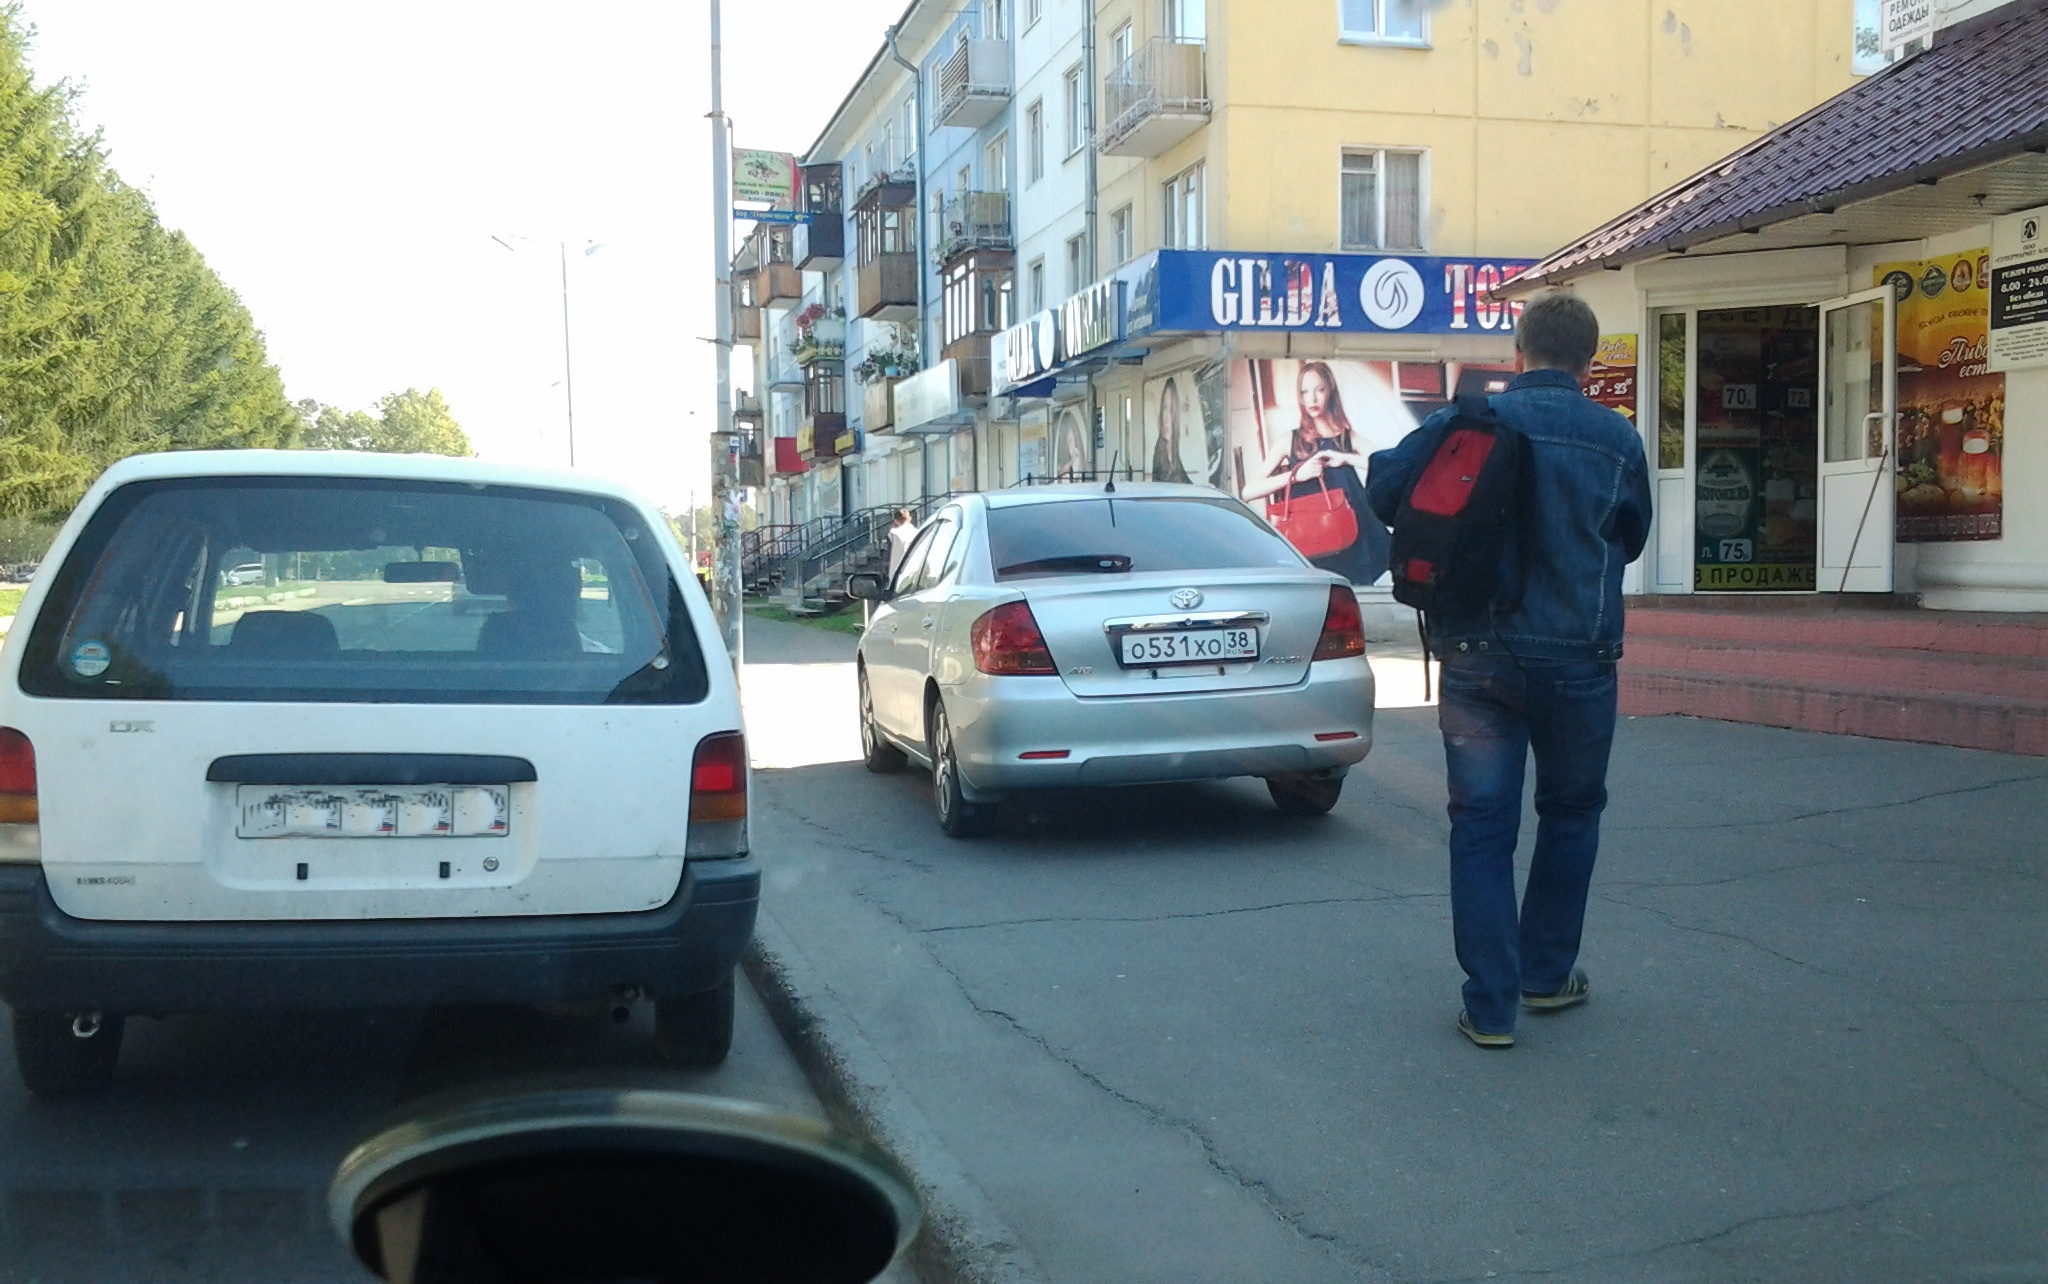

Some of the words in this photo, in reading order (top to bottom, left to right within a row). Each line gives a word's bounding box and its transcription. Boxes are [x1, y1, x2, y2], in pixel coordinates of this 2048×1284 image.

[1889, 4, 1929, 32] ОДЕЖДЫ
[1211, 258, 1342, 328] GILDA
[1711, 567, 1816, 586] ПРОДАЖЕ
[1227, 632, 1249, 649] 38
